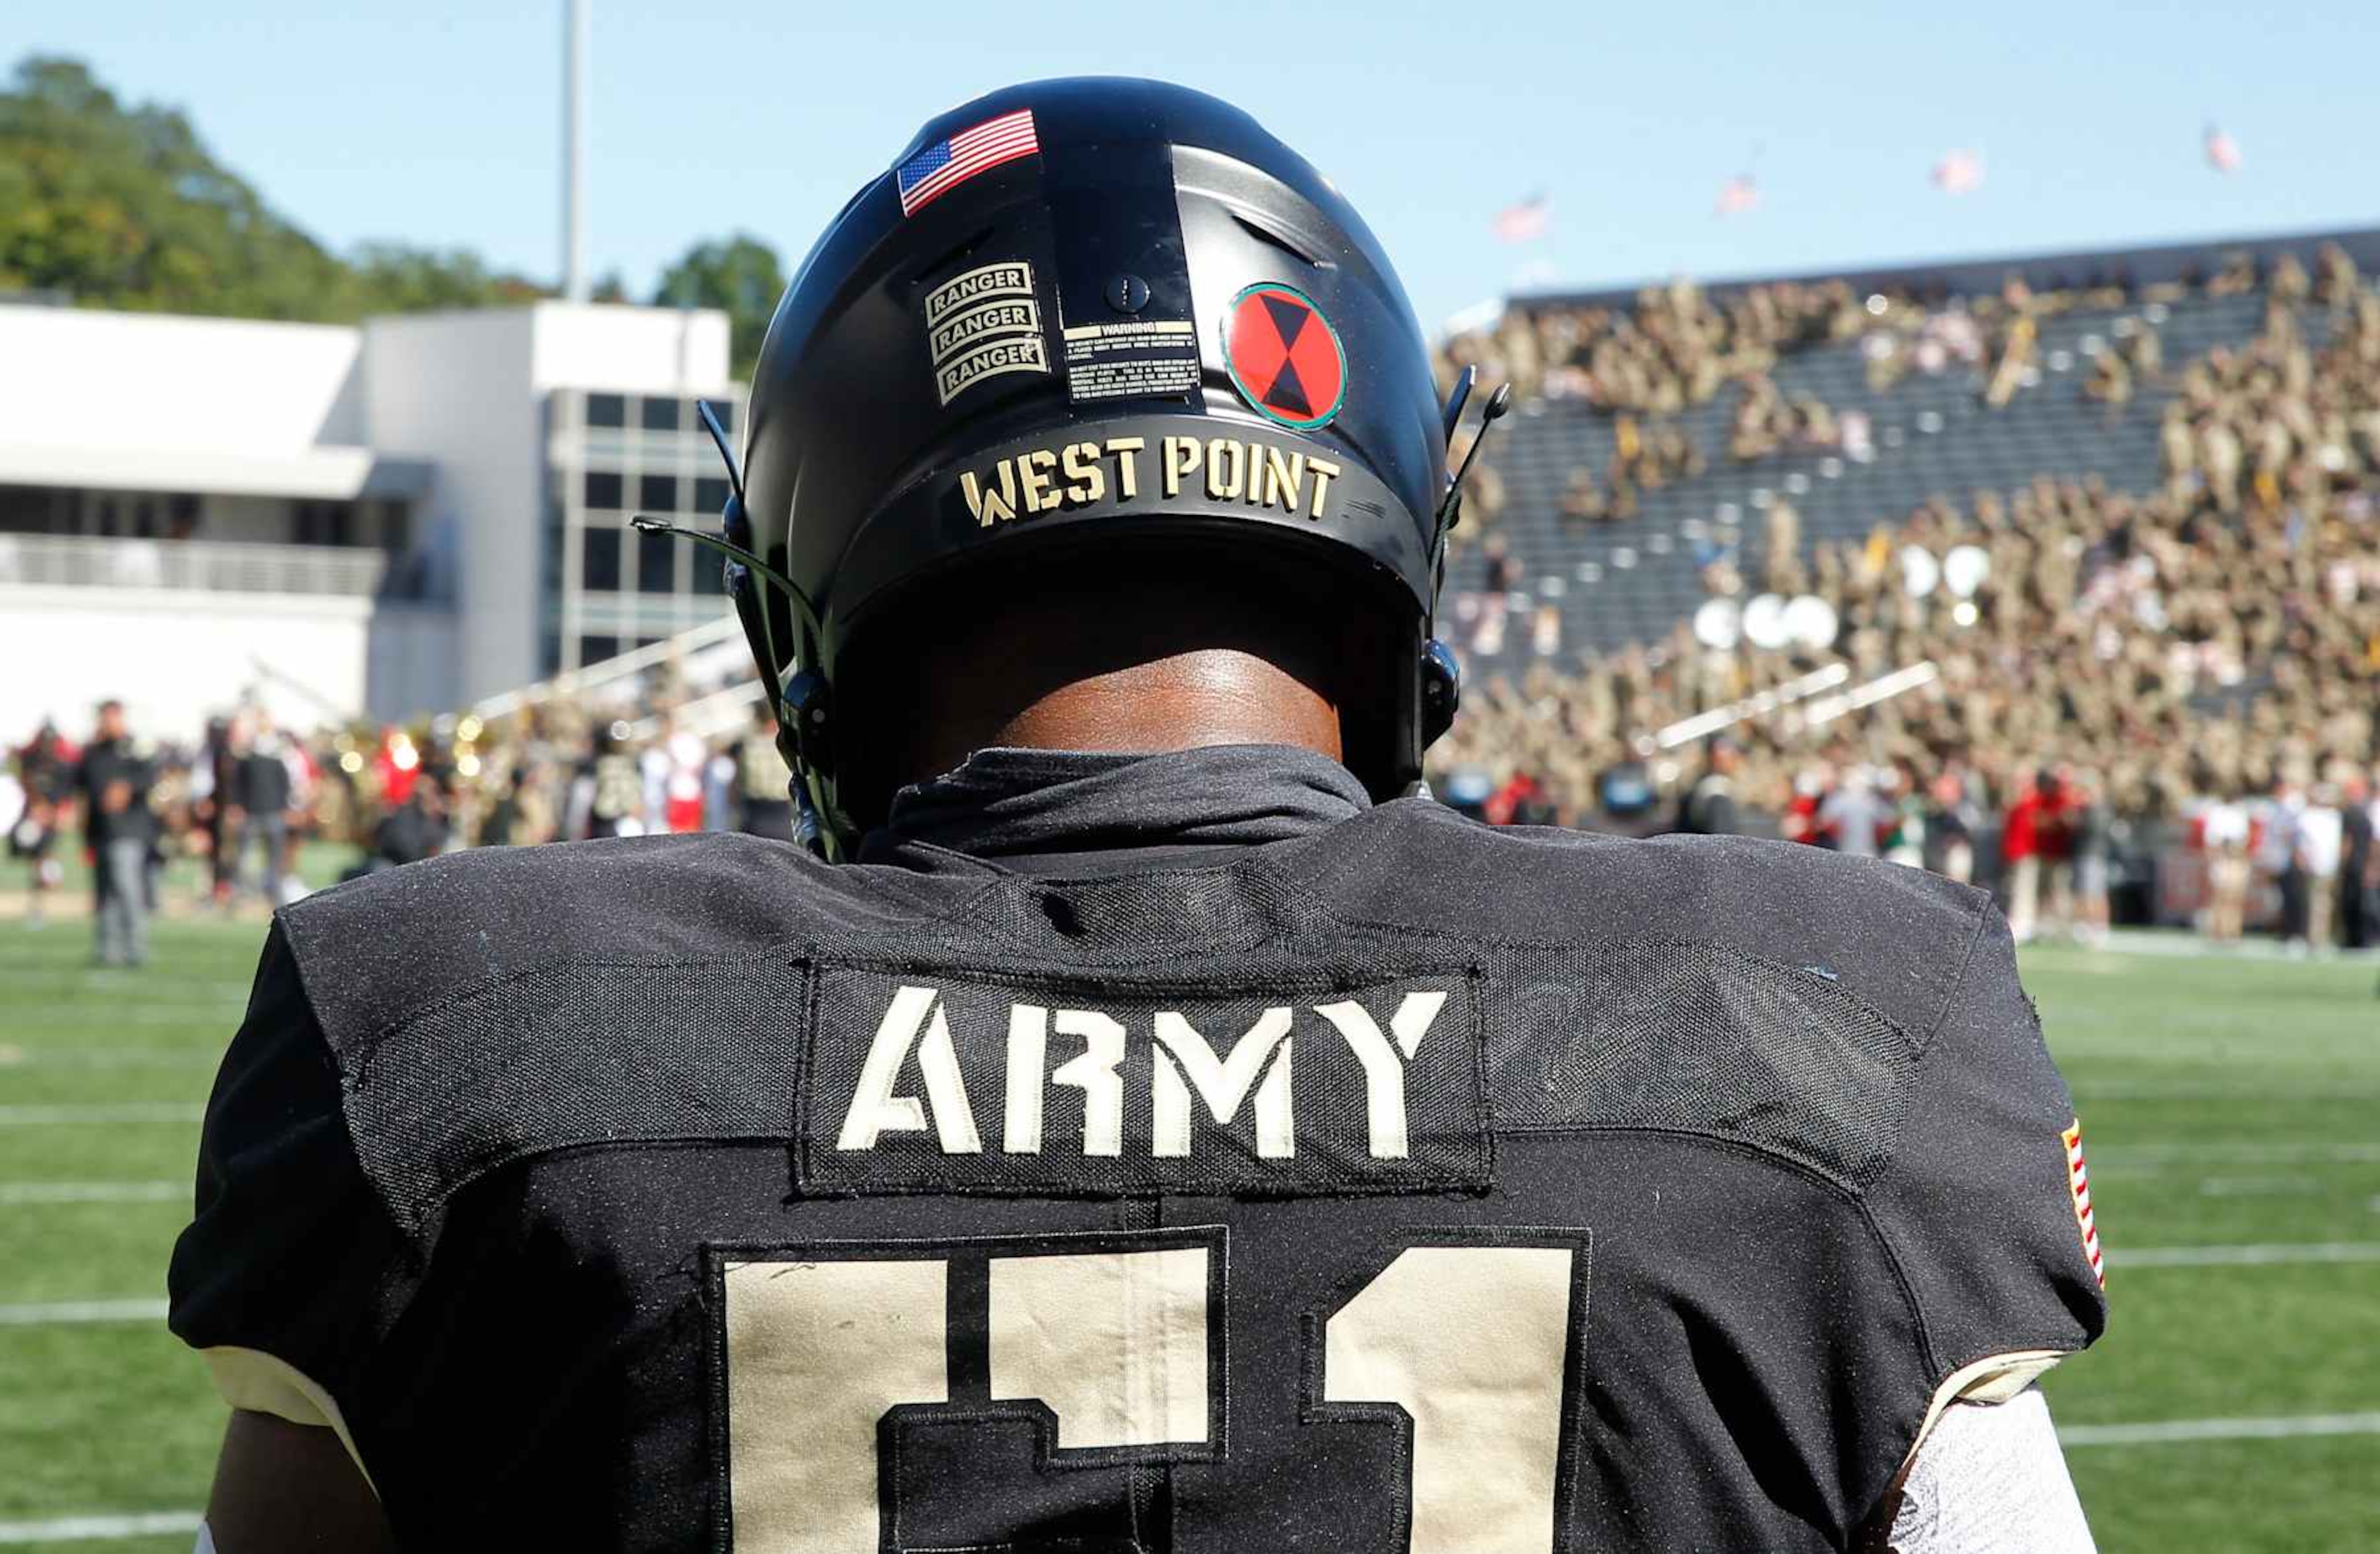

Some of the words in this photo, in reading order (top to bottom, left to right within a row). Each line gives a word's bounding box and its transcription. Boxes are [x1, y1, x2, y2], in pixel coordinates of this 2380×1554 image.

[933, 270, 1021, 313] RANGER
[938, 307, 1027, 351] RANGER
[1101, 322, 1155, 336] WARNING
[945, 345, 1036, 391] RANGER
[959, 437, 1145, 528] WEST
[1164, 436, 1341, 519] POINT
[835, 986, 1448, 1159] ARMY
